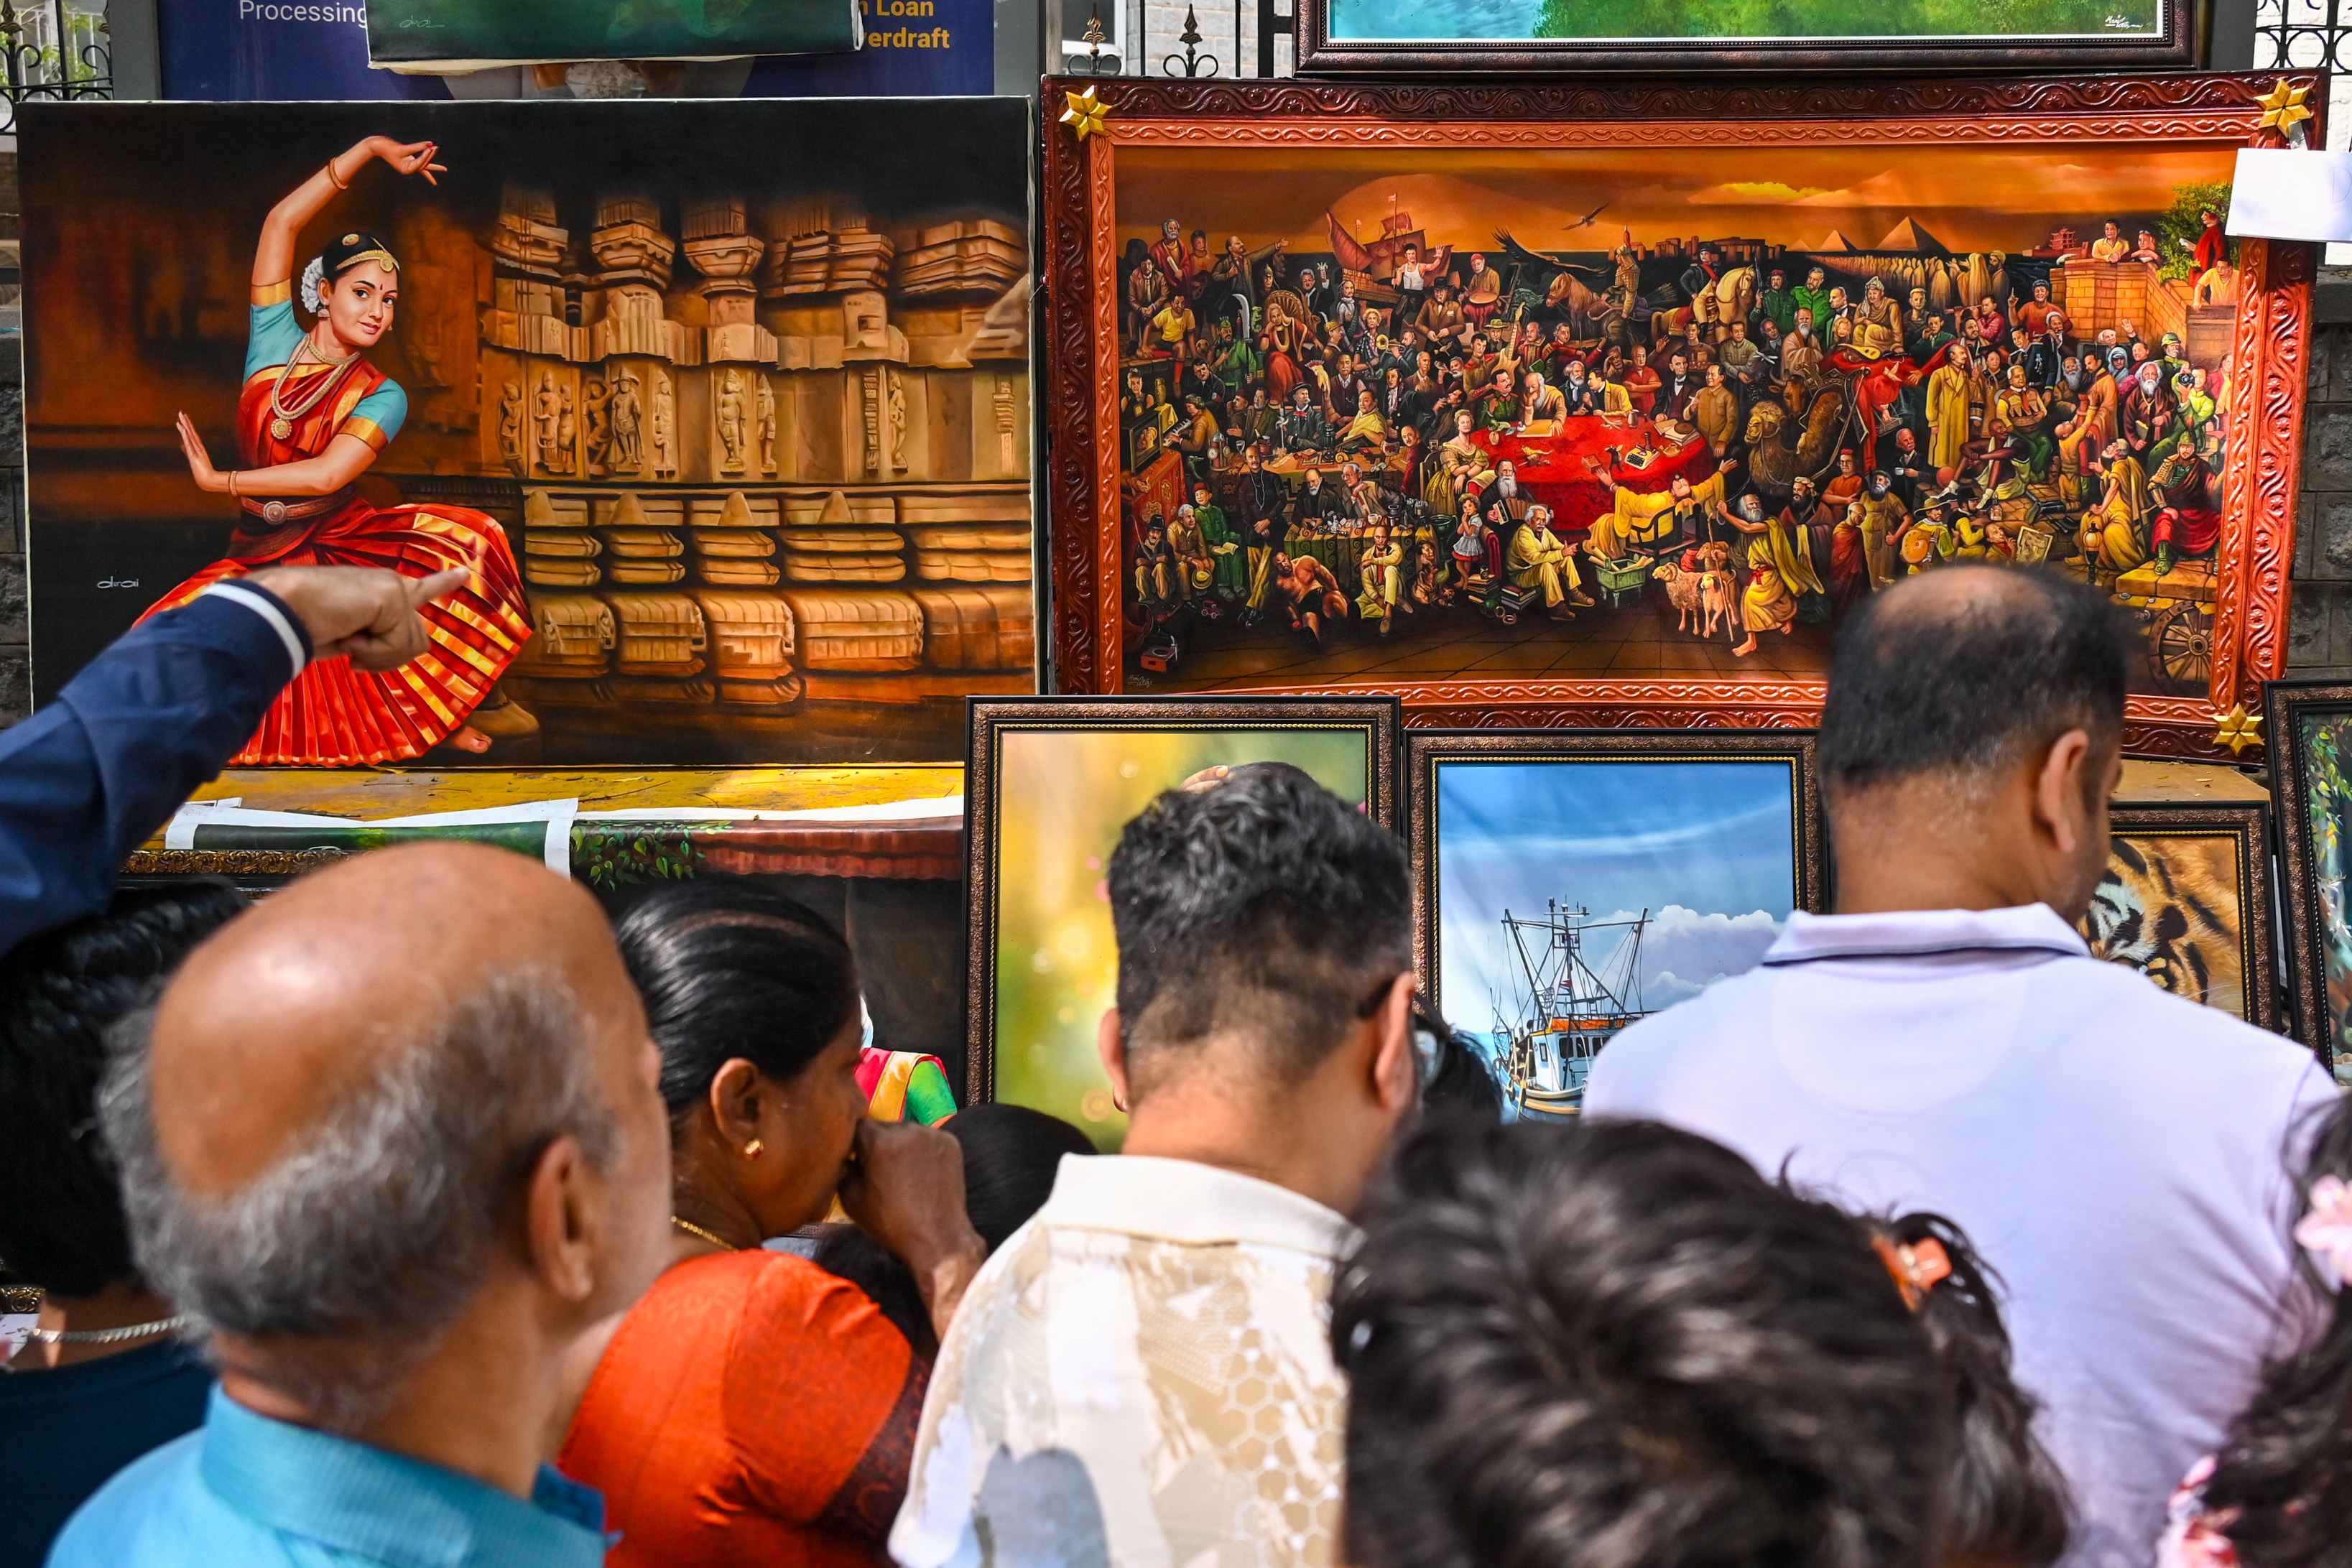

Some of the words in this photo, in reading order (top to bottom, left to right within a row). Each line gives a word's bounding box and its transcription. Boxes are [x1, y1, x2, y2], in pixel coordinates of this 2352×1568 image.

[239, 0, 367, 28] Processing
[876, 0, 934, 17] Loan
[864, 27, 950, 48] erdraft
